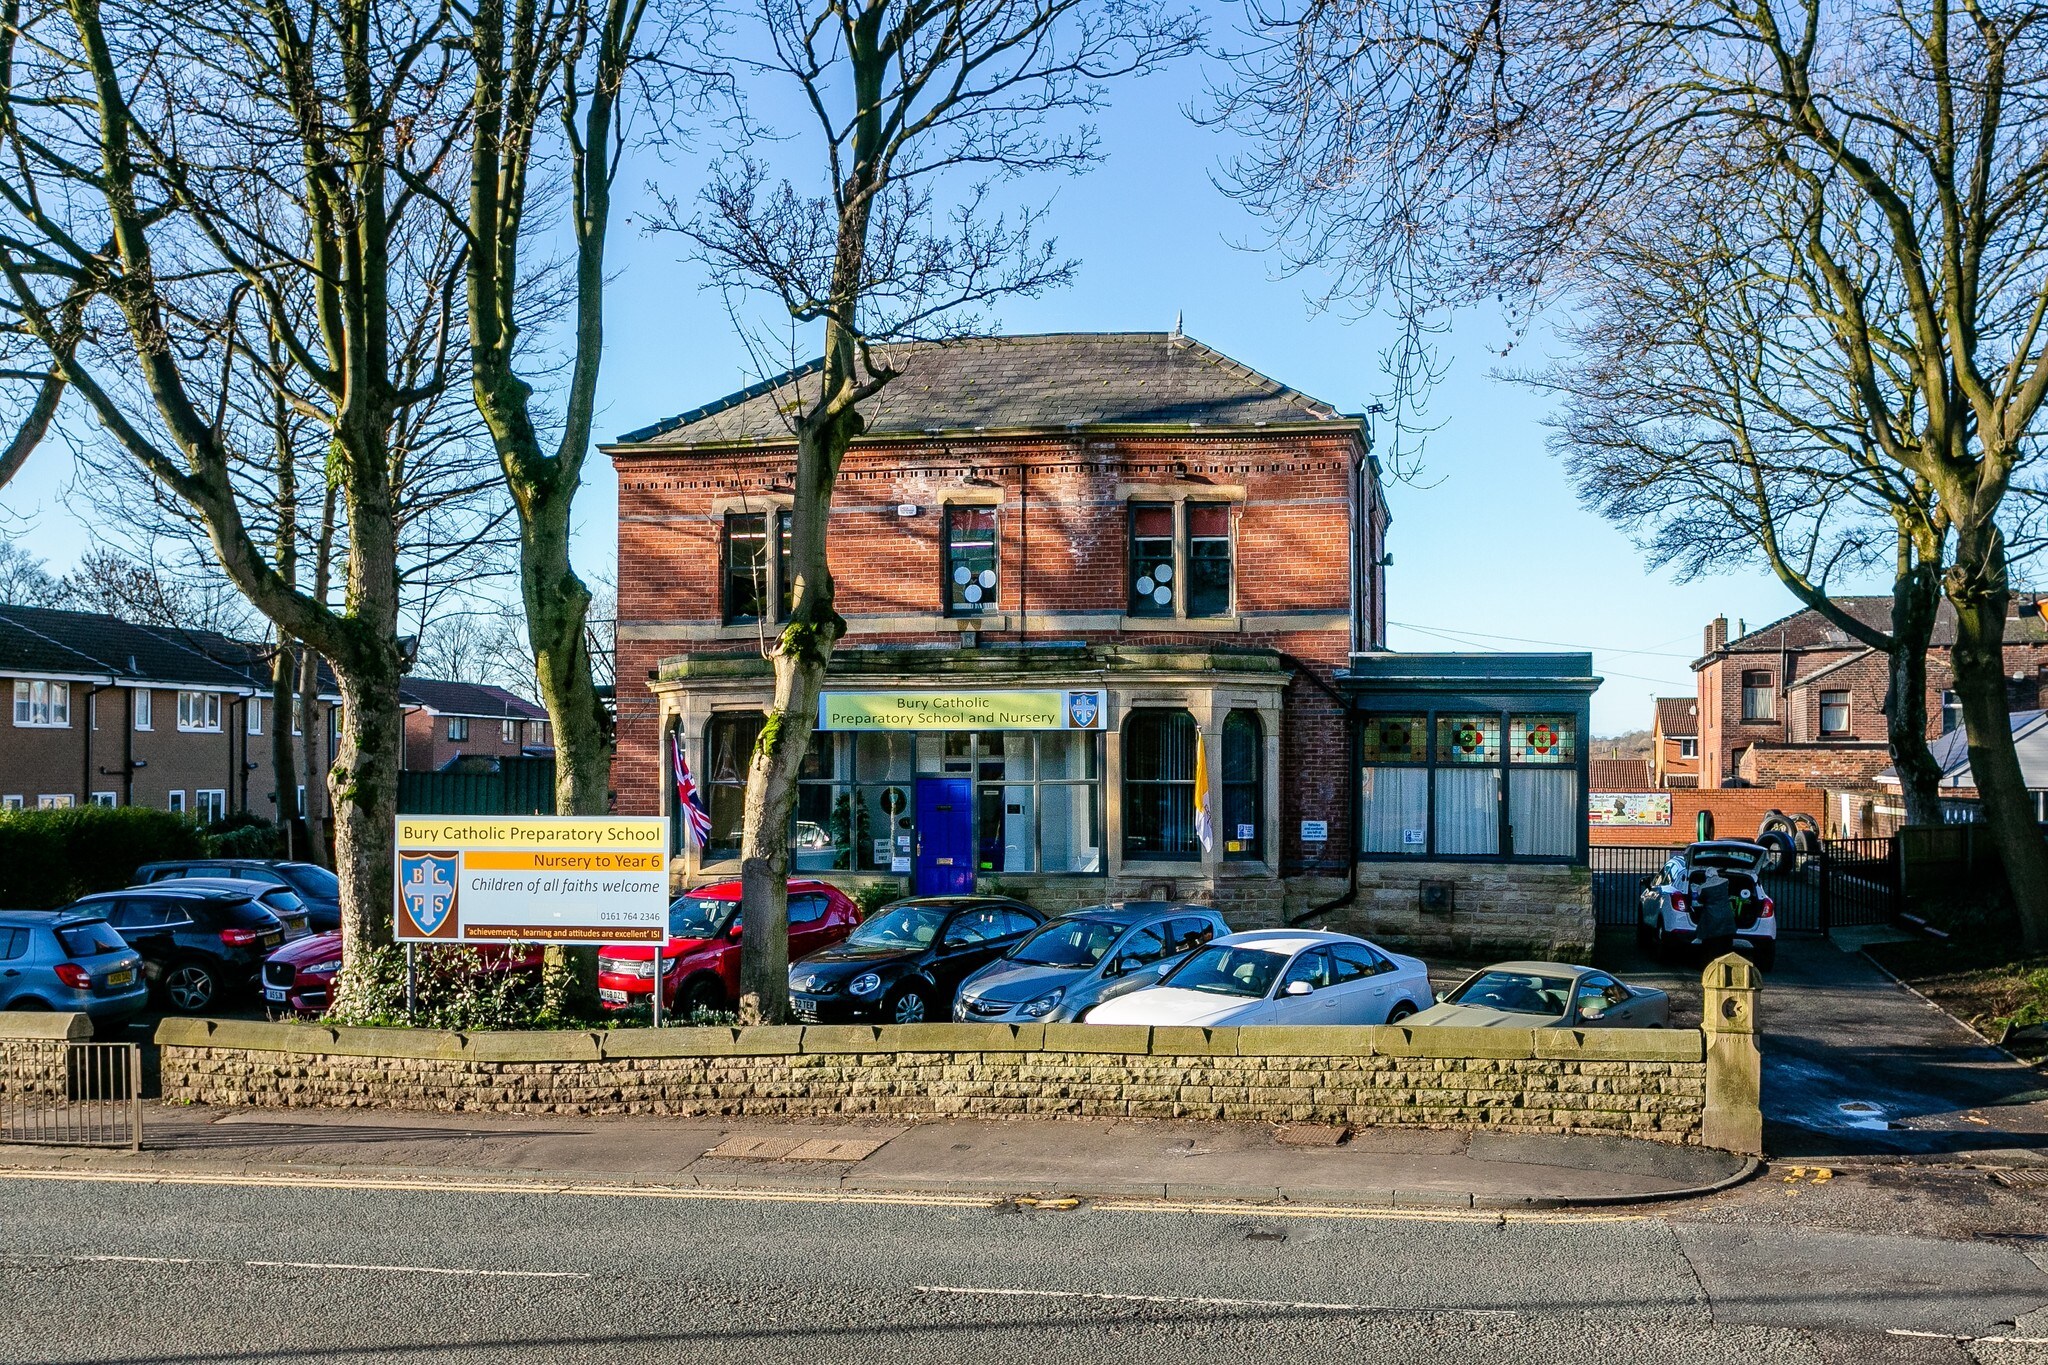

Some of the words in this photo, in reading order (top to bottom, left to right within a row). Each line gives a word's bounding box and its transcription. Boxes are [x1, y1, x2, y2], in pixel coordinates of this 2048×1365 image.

[897, 698, 927, 710] Bury
[933, 697, 989, 708] Catholic
[833, 713, 914, 725] Preparatory
[918, 713, 964, 723] School
[969, 713, 994, 722] and
[1000, 713, 1055, 724] Nursery
[404, 827, 438, 842] Bury
[444, 827, 505, 840] Catholic
[511, 827, 602, 843] Preparatory
[608, 827, 660, 841] School
[534, 854, 592, 869] Nursery
[596, 856, 610, 867] to
[615, 855, 648, 867] Year
[652, 855, 660, 867] 6
[413, 869, 423, 883] B
[434, 869, 446, 883] C
[472, 878, 523, 892] Children
[527, 878, 542, 894] of
[544, 879, 559, 892] all
[562, 879, 598, 895] faiths
[602, 881, 660, 893] welcome
[413, 897, 423, 912] P
[434, 897, 444, 912] S
[601, 912, 620, 921] 0161
[623, 912, 638, 921] 764
[641, 912, 660, 921] 2346
[523, 929, 552, 939] learning
[553, 929, 567, 938] and
[569, 929, 600, 938] attitudes
[651, 931, 660, 939] ISI
